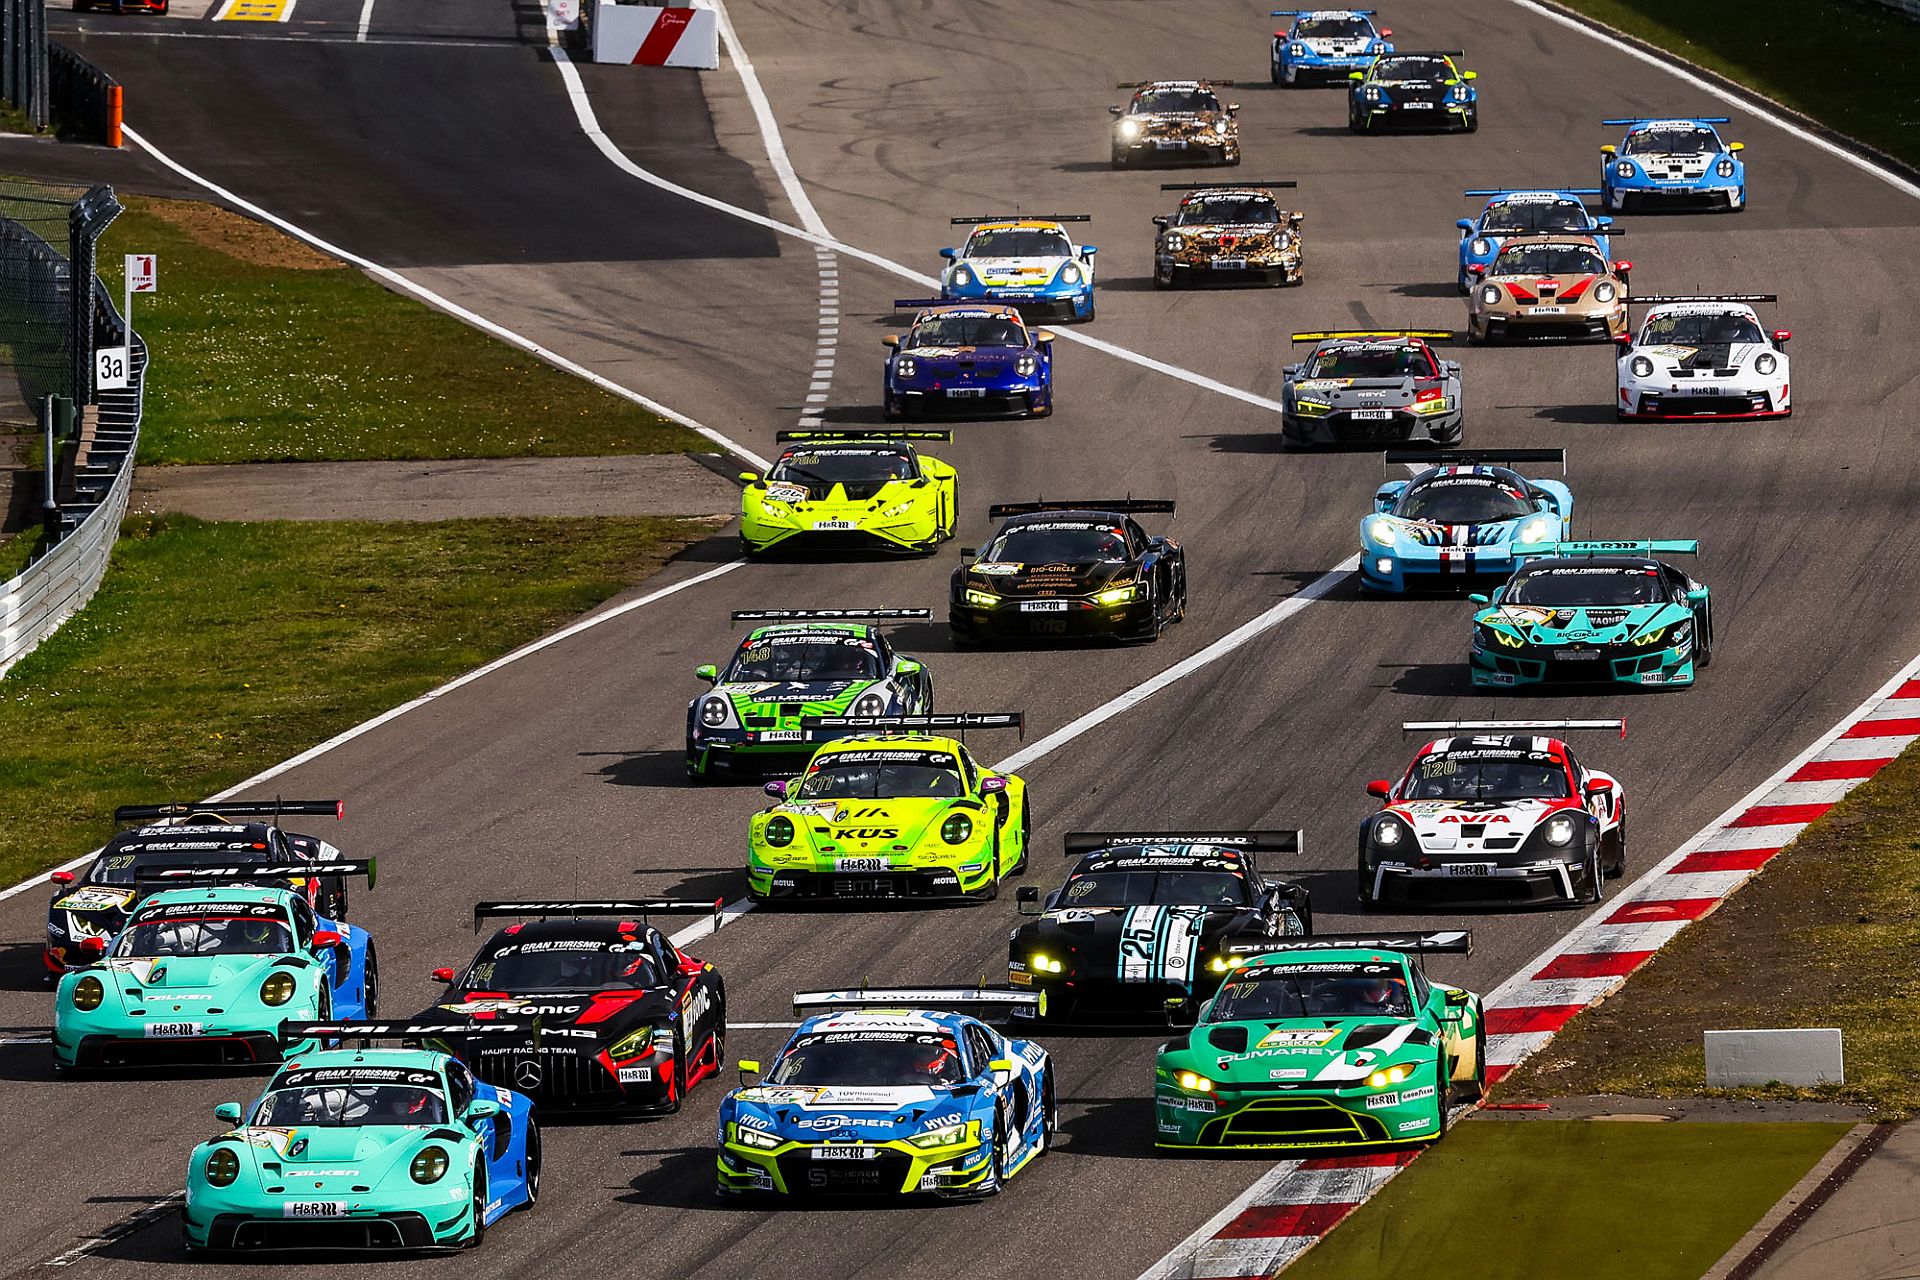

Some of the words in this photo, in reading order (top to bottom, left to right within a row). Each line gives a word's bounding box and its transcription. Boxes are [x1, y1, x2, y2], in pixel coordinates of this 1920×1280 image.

[100, 355, 123, 380] 3a
[1030, 565, 1077, 573] BIO-CIRCLE
[771, 637, 797, 645] GRAN
[820, 716, 1011, 725] PORSCHE
[839, 752, 871, 760] GRAN
[1447, 750, 1476, 758] GRAN
[1421, 760, 1456, 779] 120
[835, 828, 899, 839] KÜS
[146, 842, 175, 850] GRAN
[1113, 837, 1247, 845] MOTORWORLD
[107, 855, 135, 871] 27
[840, 859, 866, 871] H&R
[1449, 865, 1474, 877] H&R
[933, 877, 957, 885] MOTUL
[165, 905, 196, 914] GRAN
[521, 941, 552, 952] GRAN
[553, 940, 602, 950] TURISMO
[1273, 965, 1305, 973] GRAN
[1232, 982, 1260, 1000] 17
[152, 1023, 180, 1036] H&R
[825, 1033, 858, 1041] GRAN
[859, 1032, 909, 1040] TURISMO
[551, 1047, 577, 1055] TEAM
[1216, 1048, 1341, 1064] DUMAREY
[315, 1070, 348, 1079] GRAN
[349, 1069, 400, 1077] TURISMO
[620, 1070, 639, 1080] H&R
[1367, 1095, 1385, 1107] H&R
[798, 1116, 894, 1130] SCHERER
[821, 1147, 850, 1159] H&R
[284, 1169, 360, 1178] FALKEN
[292, 1203, 322, 1216] H&R
